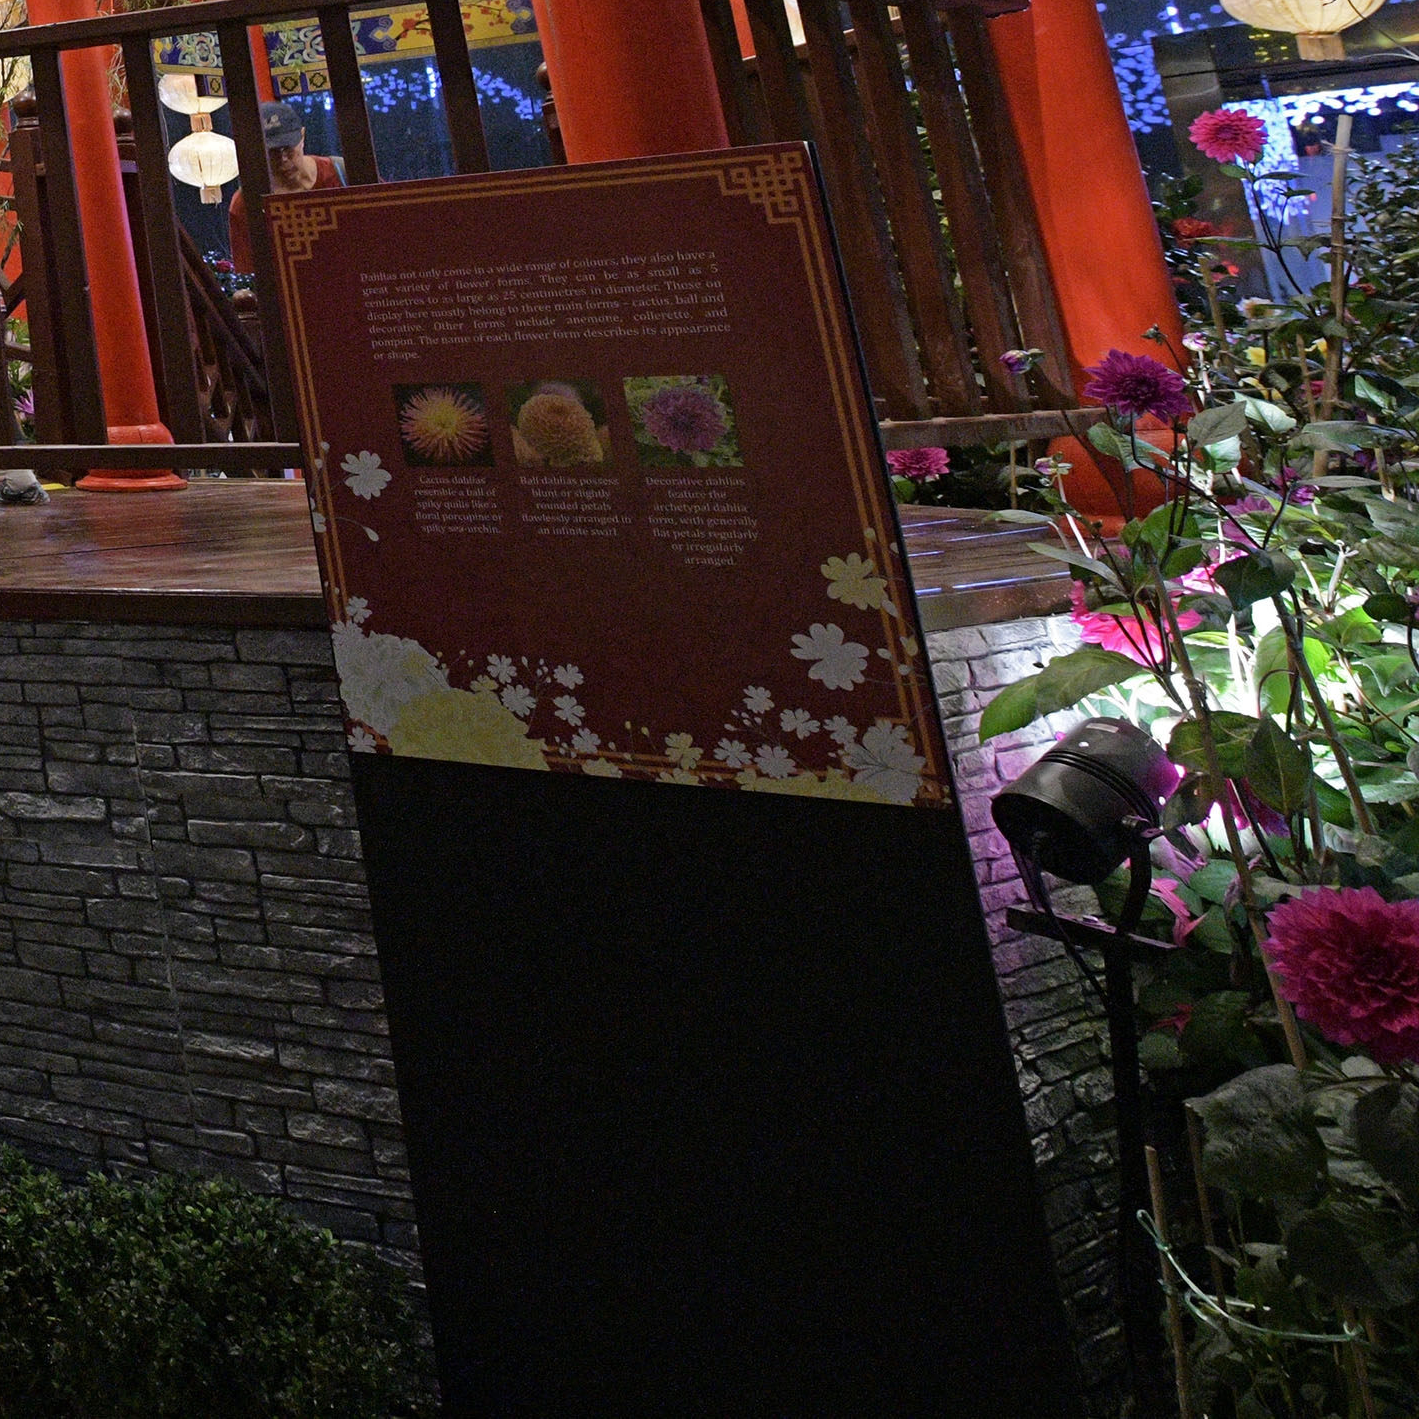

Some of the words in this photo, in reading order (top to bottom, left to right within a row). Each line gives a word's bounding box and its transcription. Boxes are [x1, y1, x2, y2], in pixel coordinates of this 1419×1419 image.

[360, 272, 396, 282] Dahlias
[400, 271, 416, 279] not
[419, 268, 441, 280] only
[444, 268, 471, 277] come
[474, 266, 485, 274] in
[496, 264, 522, 272] wide
[525, 261, 557, 272] range
[560, 259, 570, 269] of
[622, 255, 646, 266] they
[650, 253, 674, 263] also
[677, 251, 705, 260] have
[363, 287, 389, 296] great
[395, 283, 430, 293] variety
[438, 281, 449, 290] of
[456, 278, 491, 289] flower
[539, 275, 568, 285] They
[576, 273, 595, 282] can
[604, 271, 618, 280] be
[627, 271, 639, 279] as
[648, 267, 680, 278] small
[365, 298, 425, 308] centimetres
[428, 296, 439, 304] to
[456, 293, 483, 304] large
[503, 291, 516, 300] 25
[520, 286, 586, 299] centimetres
[591, 287, 602, 295] in
[664, 281, 701, 290] Those
[706, 280, 721, 288] on
[367, 312, 403, 322] display
[405, 310, 428, 319] here
[431, 307, 466, 317] mostly
[469, 304, 506, 316] belong
[521, 303, 551, 313] three
[555, 300, 582, 311] main
[586, 298, 619, 309] forms
[675, 294, 698, 304] ball
[703, 292, 724, 303] and
[433, 321, 464, 330] Other
[474, 319, 505, 329] forms
[514, 316, 556, 327] include
[705, 307, 728, 318] and
[419, 335, 439, 345] The
[441, 334, 471, 344] name
[473, 332, 483, 342] of
[486, 331, 511, 342] each
[514, 330, 549, 340] flower
[553, 328, 581, 339] form
[583, 327, 639, 338] describes
[642, 326, 656, 335] its
[660, 323, 731, 336] appearance
[374, 351, 385, 360] or
